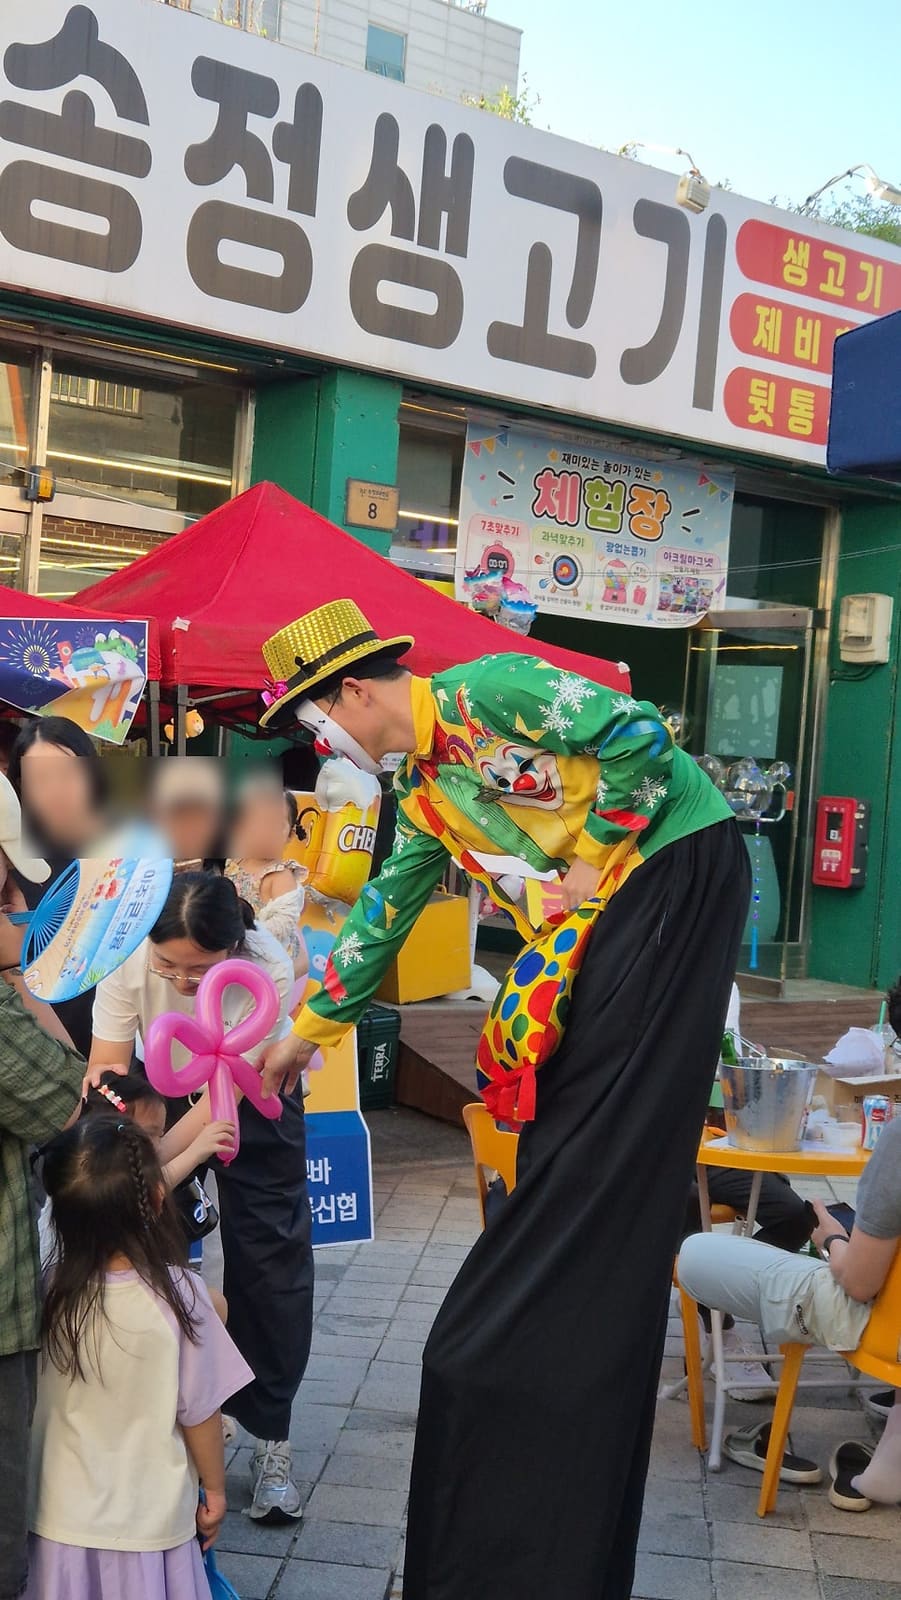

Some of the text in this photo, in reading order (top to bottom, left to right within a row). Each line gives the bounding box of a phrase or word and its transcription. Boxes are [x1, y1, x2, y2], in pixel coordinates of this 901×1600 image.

[0, 4, 727, 412] 송정생고기
[782, 238, 884, 309] 생고기
[753, 304, 850, 365] 제비
[748, 378, 830, 436] 뒷통
[562, 452, 652, 481] 재미있는 놀이가 있는
[368, 502, 377, 519] 8
[532, 467, 672, 542] 체험장
[481, 519, 519, 536] 7초맞추기
[663, 551, 714, 568] 아크릴마그넷
[371, 1043, 387, 1082] TERRA
[306, 1157, 332, 1185] 바
[308, 1191, 357, 1224] 신협
